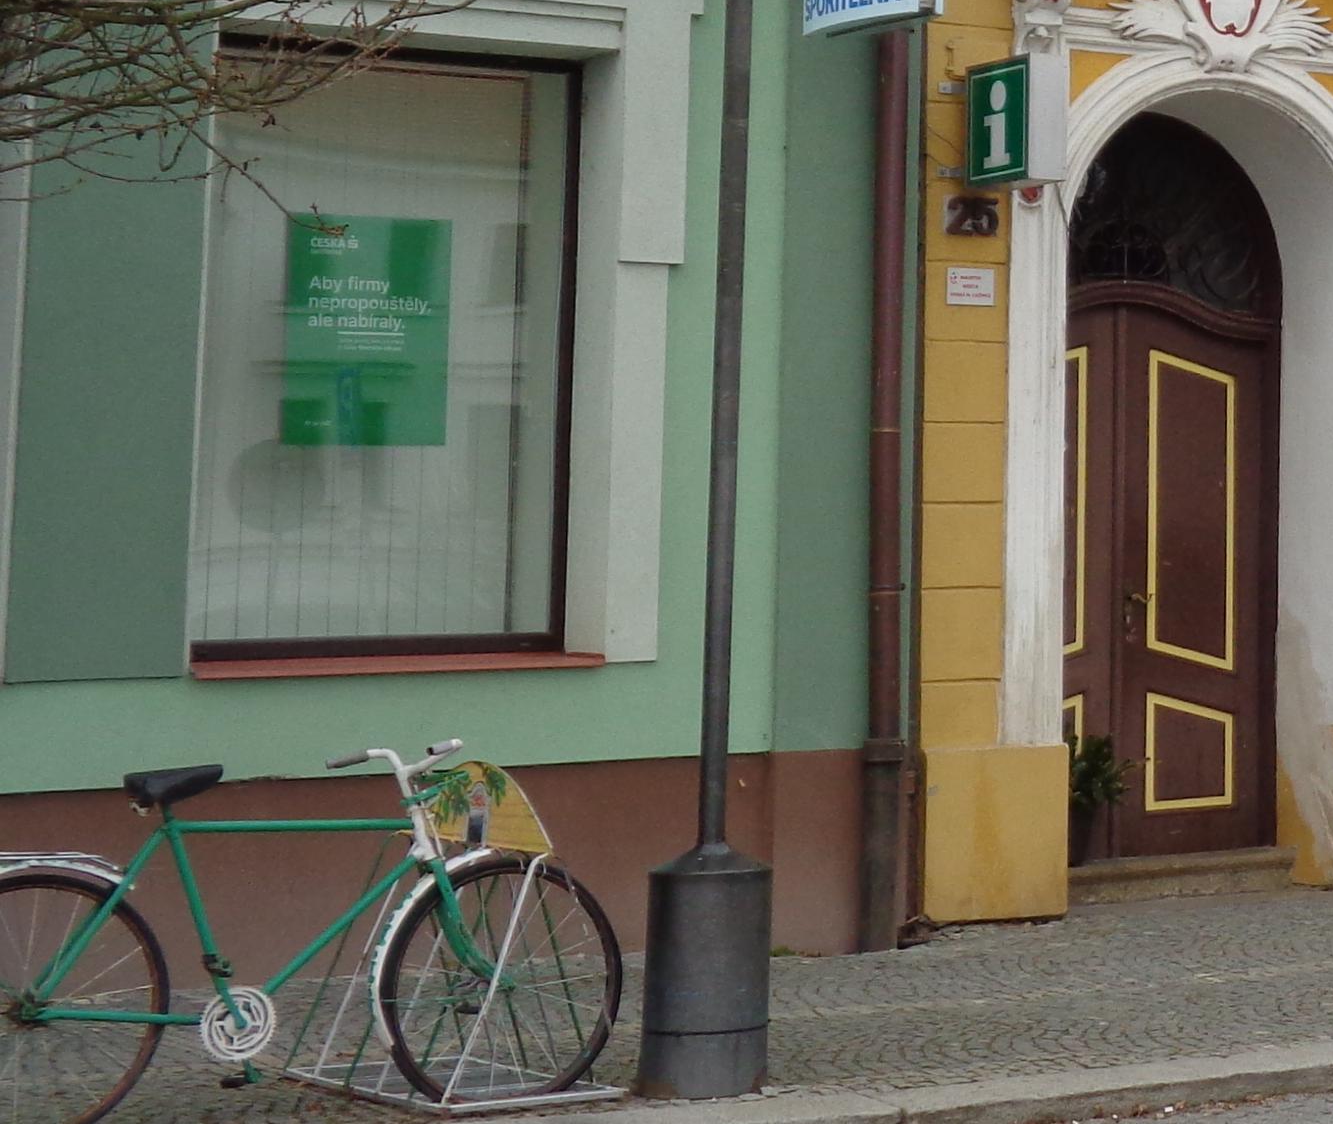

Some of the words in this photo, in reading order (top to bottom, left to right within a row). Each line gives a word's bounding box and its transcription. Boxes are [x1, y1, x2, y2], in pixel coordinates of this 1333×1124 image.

[946, 195, 1000, 237] 25
[308, 275, 343, 294] Aby
[347, 276, 390, 295] firmy
[308, 294, 432, 316] nepropouštěly,
[308, 313, 334, 328] ale
[337, 313, 405, 332] nabíraly.
